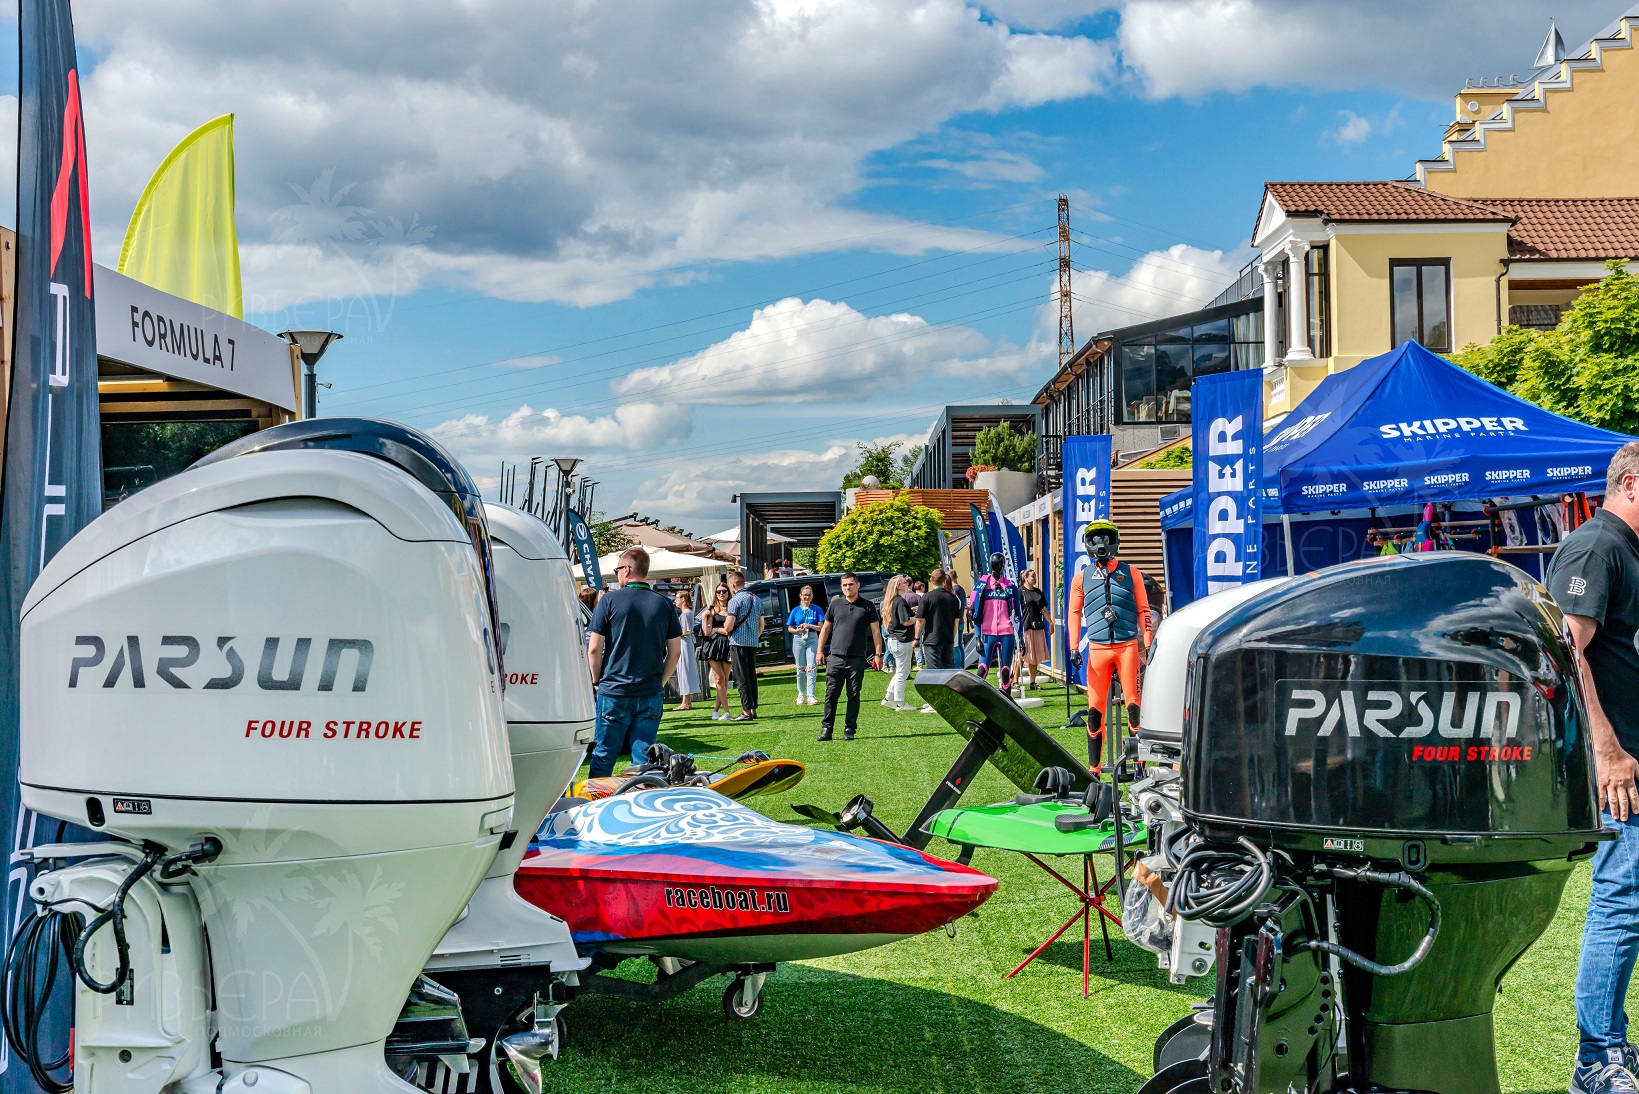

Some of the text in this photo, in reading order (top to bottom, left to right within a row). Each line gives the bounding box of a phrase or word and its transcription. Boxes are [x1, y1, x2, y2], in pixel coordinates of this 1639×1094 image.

[131, 305, 235, 371] FORMULA 7
[1379, 417, 1529, 438] SKIPPER
[1404, 433, 1461, 442] MARINE
[1424, 472, 1470, 485] SKIPPER
[1485, 469, 1530, 481] SKIPPER
[1546, 465, 1592, 477] SKIPPER
[1247, 447, 1257, 524] PARTS
[1302, 483, 1347, 495] SKIPPER
[1363, 478, 1408, 491] SKIPPER
[68, 635, 375, 693] PARSUN
[1284, 689, 1522, 738] PARSUN
[244, 720, 423, 739] FOUR STROKE
[1412, 746, 1533, 761] FOUR STROKE
[664, 886, 790, 912] raceboat.ru
